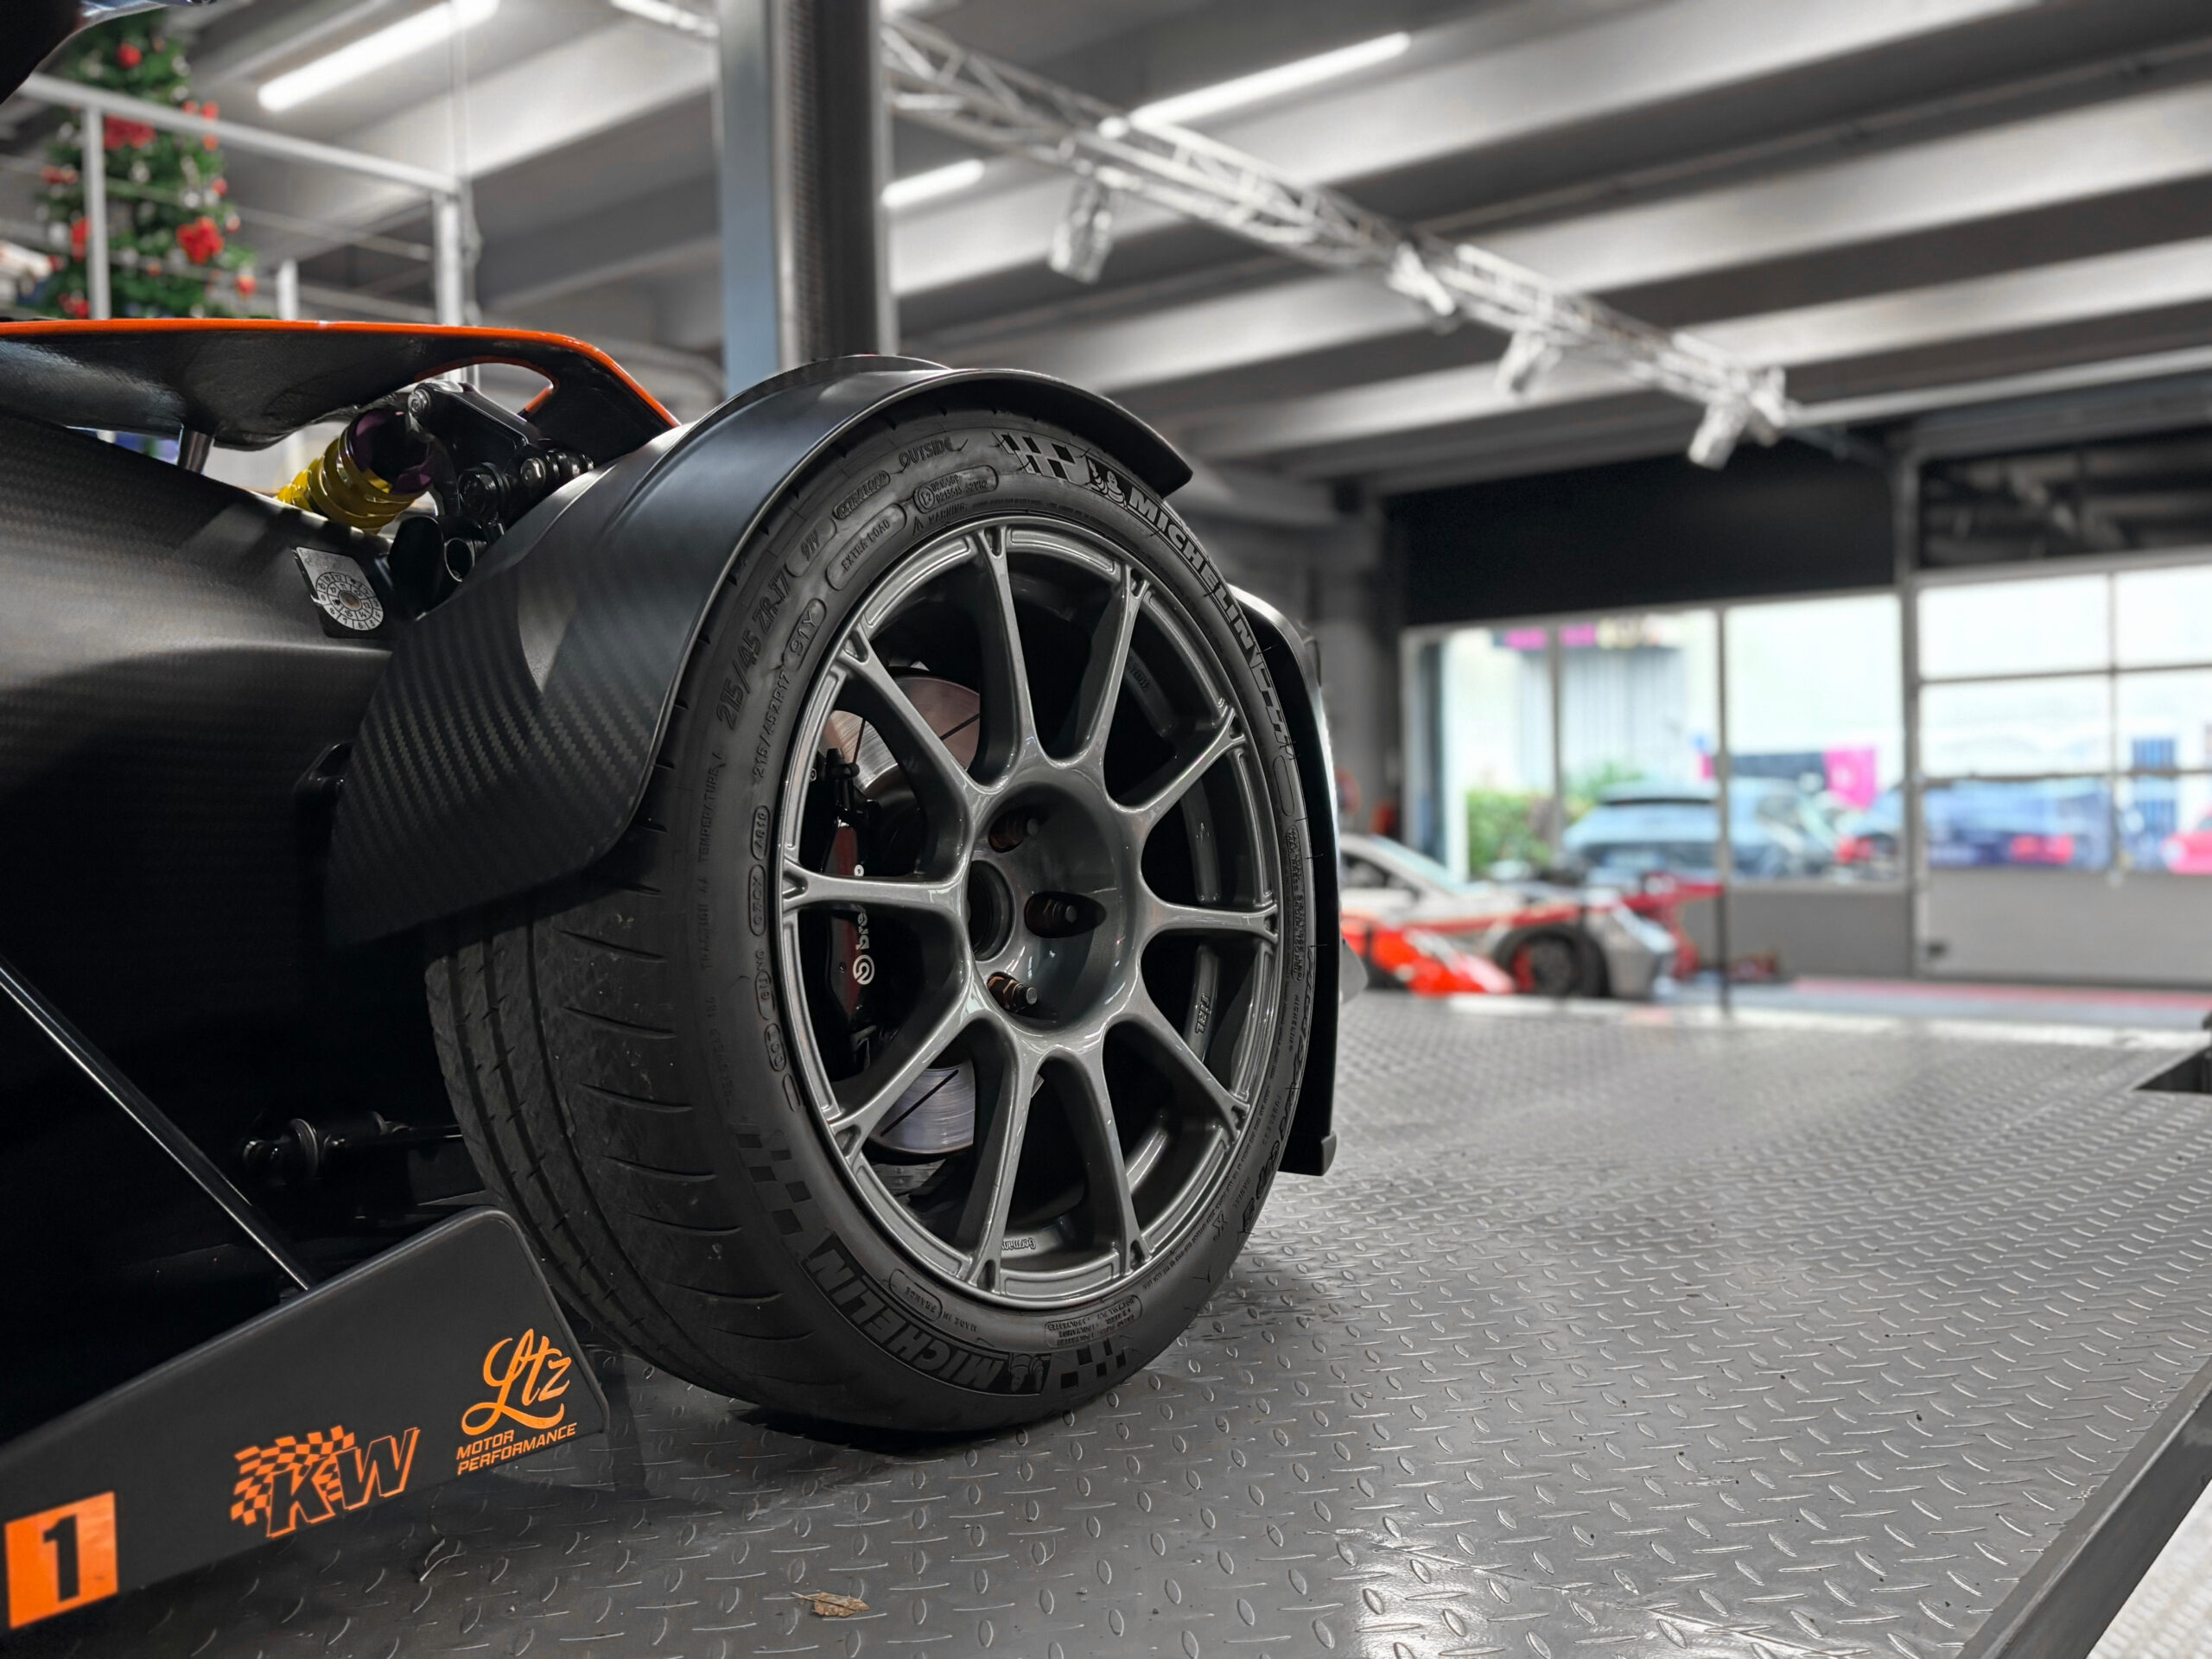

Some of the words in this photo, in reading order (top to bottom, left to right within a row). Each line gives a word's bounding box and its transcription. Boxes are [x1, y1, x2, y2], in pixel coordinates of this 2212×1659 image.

[841, 539, 868, 573] EXTRA
[868, 518, 891, 542] LOAD
[1128, 485, 1254, 650] MICHELIN
[790, 606, 817, 657] 91Y
[716, 629, 762, 731] 215/45
[1002, 1237, 1037, 1250] German
[806, 1249, 1003, 1389] MICHELIN
[461, 1328, 570, 1436] Ltz
[265, 1427, 420, 1539] KW
[456, 1429, 516, 1462] MOTOR
[456, 1422, 578, 1476] PERFORMANCE
[43, 1514, 81, 1603] 1
